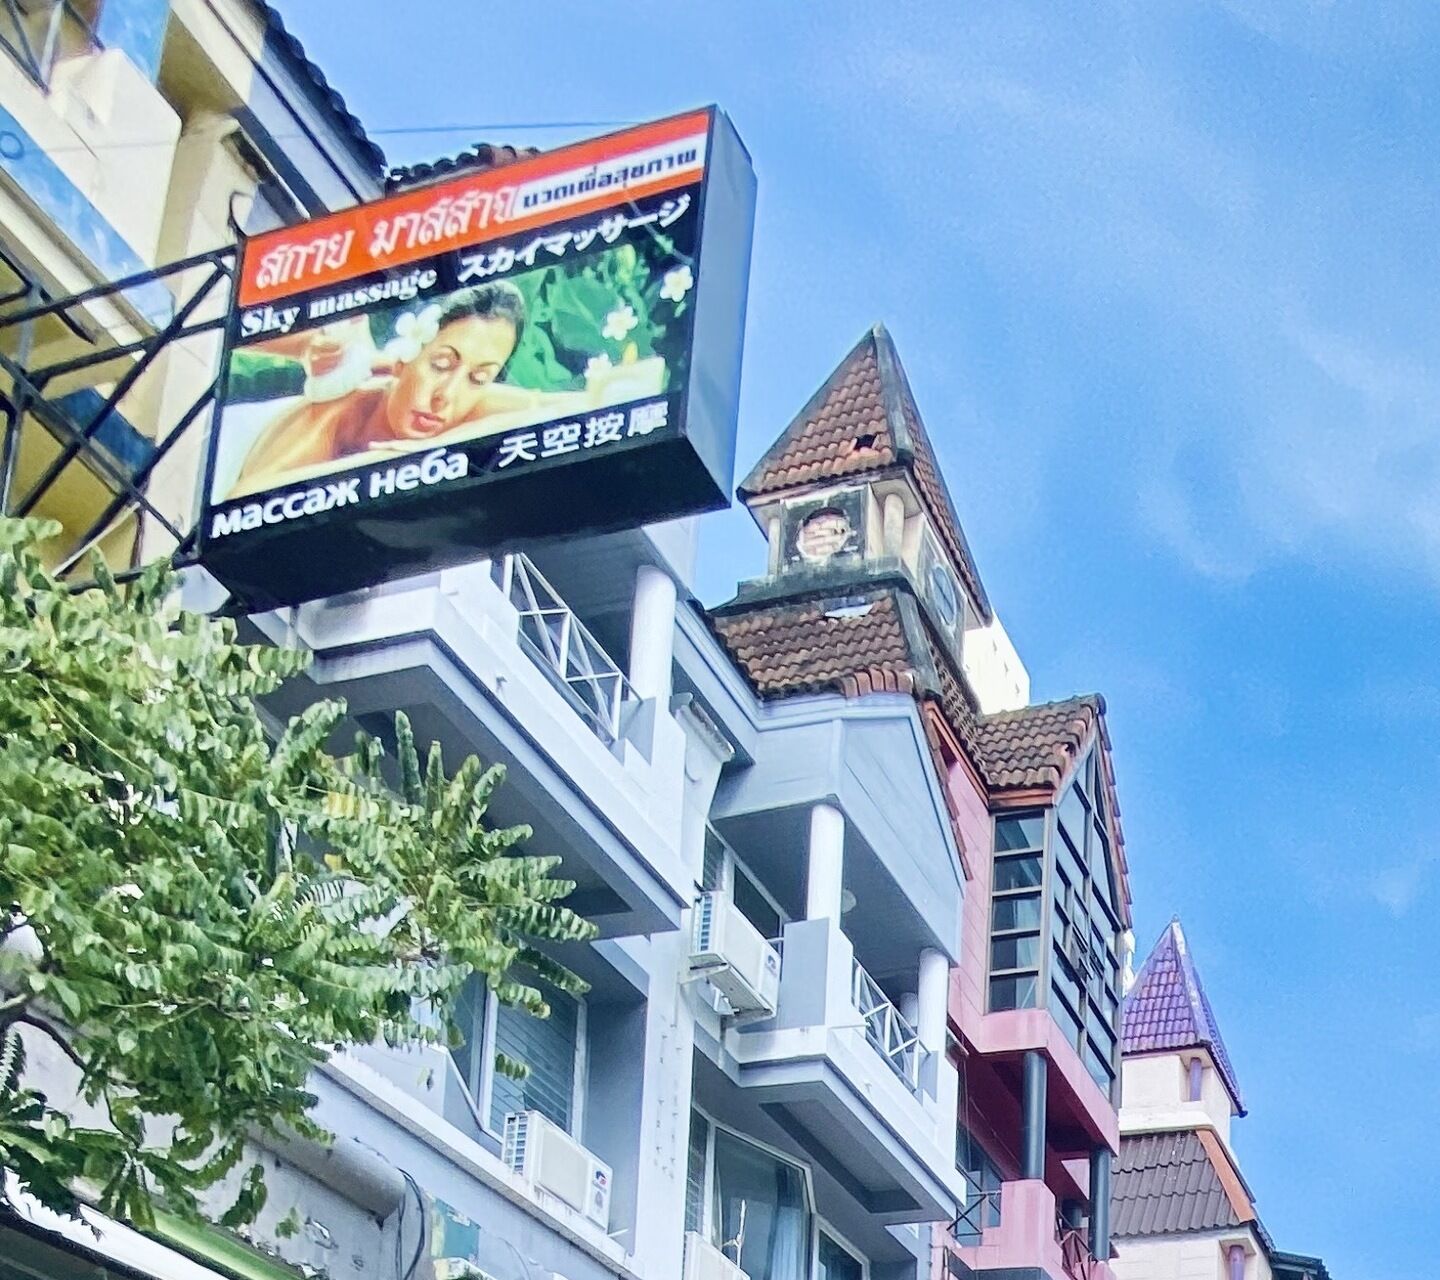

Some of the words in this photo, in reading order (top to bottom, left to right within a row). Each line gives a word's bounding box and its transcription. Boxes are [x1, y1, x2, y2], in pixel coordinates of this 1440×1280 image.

[524, 149, 697, 209] นวดเพื่อสุขภาพ
[256, 229, 355, 289] สกาย
[457, 193, 691, 282] スカイマッサージ
[241, 304, 301, 338] Sky
[309, 269, 437, 319] massage
[498, 401, 669, 468] 天空按摩
[369, 448, 469, 498] неба
